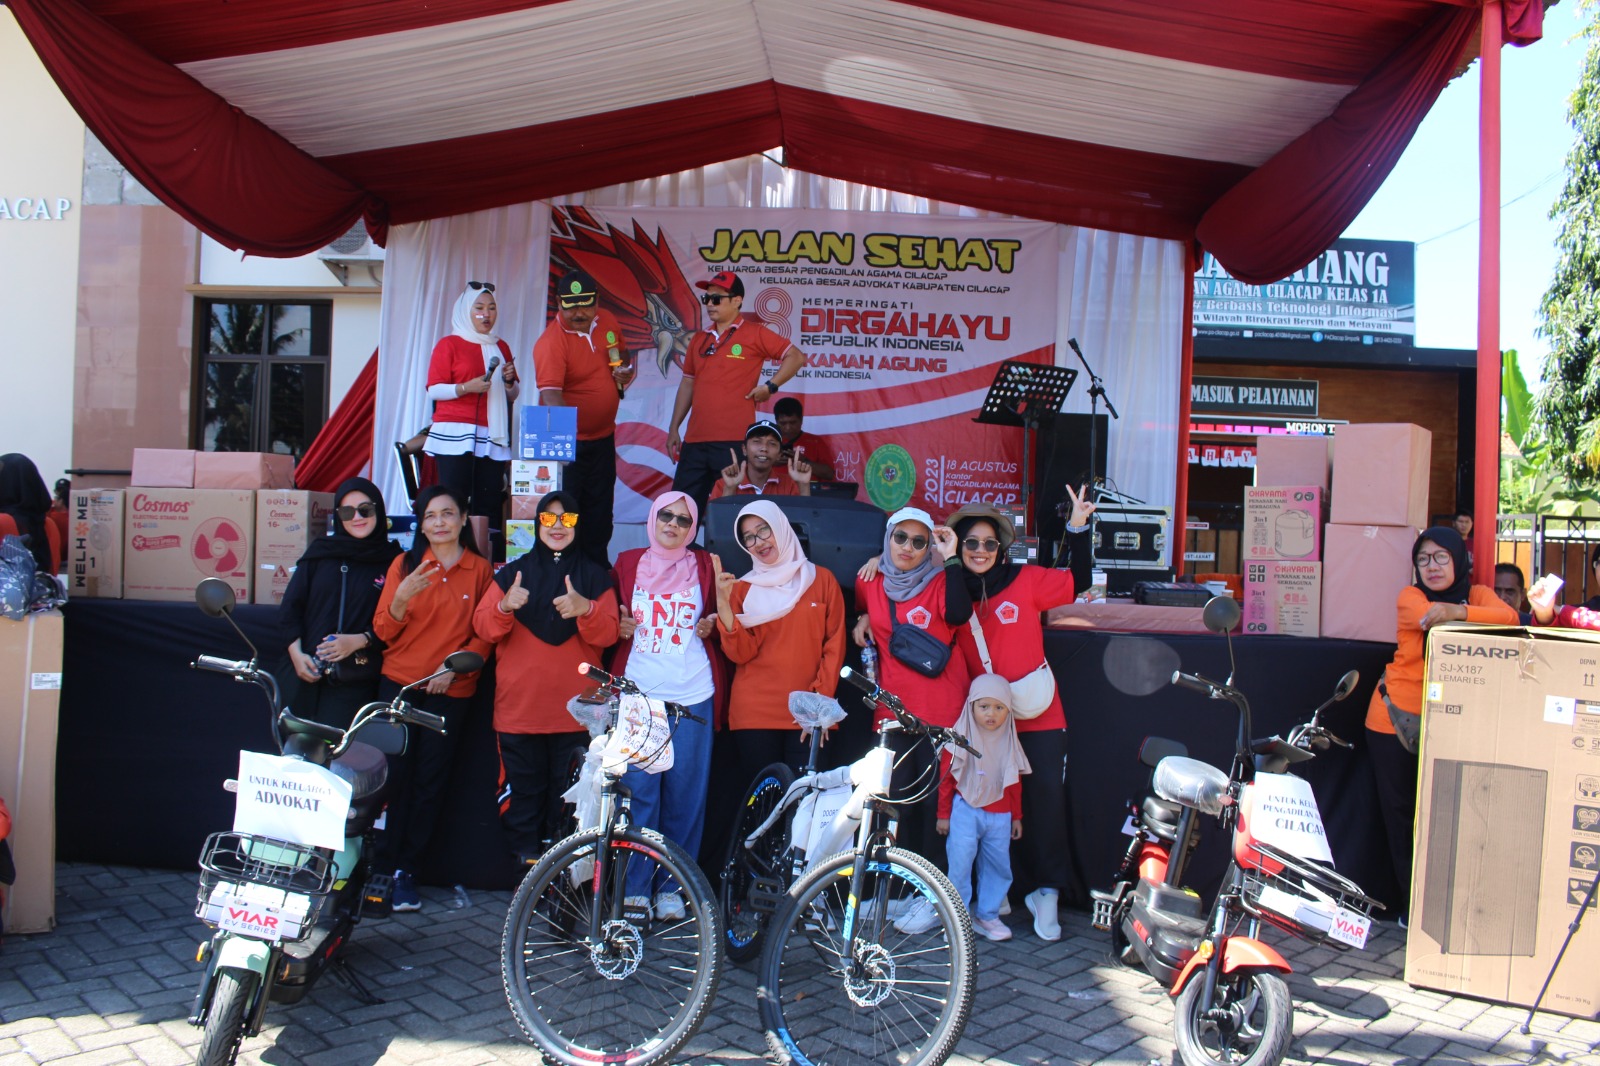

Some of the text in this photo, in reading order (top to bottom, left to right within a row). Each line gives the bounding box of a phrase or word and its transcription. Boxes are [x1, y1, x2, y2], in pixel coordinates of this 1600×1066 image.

[0, 197, 71, 220] ACAP
[698, 229, 1022, 273] JALAN SEHAT
[707, 265, 948, 281] KELUARGA BESAR PENGADILAN AGAMA CILACAP
[1282, 250, 1389, 287] TANG
[759, 277, 1010, 294] KELUARGA BESAR ADVOKAT KABUPATEN CILACAP
[1213, 281, 1262, 298] AGAMA
[1266, 283, 1322, 300] CILACAP
[1327, 286, 1369, 303] KELAS
[1372, 289, 1388, 304] 1A
[802, 297, 914, 310] MEMPERINGATI
[1206, 299, 1263, 311] Berbasis
[1267, 301, 1331, 316] Teknologi
[1335, 304, 1398, 319] Informasi
[800, 307, 1011, 341] DIRGAHAYU
[1203, 313, 1242, 323] Wilayah
[1245, 315, 1290, 325] Birokrasi
[1293, 317, 1324, 327] Bersih
[1327, 319, 1346, 328] dan
[1348, 320, 1392, 331] Melayani
[800, 334, 964, 352] REPUBLIK INDONESIA
[878, 356, 947, 373] AGUNG
[760, 368, 872, 380] REPLIK INDONESIA
[1191, 384, 1315, 407] MASUK PELAYANAN
[1286, 422, 1326, 434] MOHON
[833, 451, 860, 467] AJU
[946, 460, 1018, 473] 18 AGUSTUS
[925, 458, 939, 502] 2023
[945, 472, 973, 480] Kantor
[945, 480, 1020, 490] PENGADILAN AGAMA
[133, 493, 191, 513] Cosmos
[944, 489, 1016, 507] CILACAP
[1441, 643, 1520, 660] SHARP
[1439, 662, 1483, 675] SJ-X187
[1580, 658, 1597, 666] DEPAN
[1438, 674, 1486, 685] LEMARI ES
[1447, 705, 1461, 714] DB
[249, 775, 278, 788] UNTUK
[254, 790, 321, 812] ADVOKAT
[1268, 794, 1296, 805] UNTUK
[1263, 804, 1314, 817] PENGADILAN
[228, 906, 279, 929] VIAR
[224, 918, 276, 936] EV SERIES
[1336, 918, 1364, 939] VIAR
[1332, 928, 1363, 945] EV SERIES
